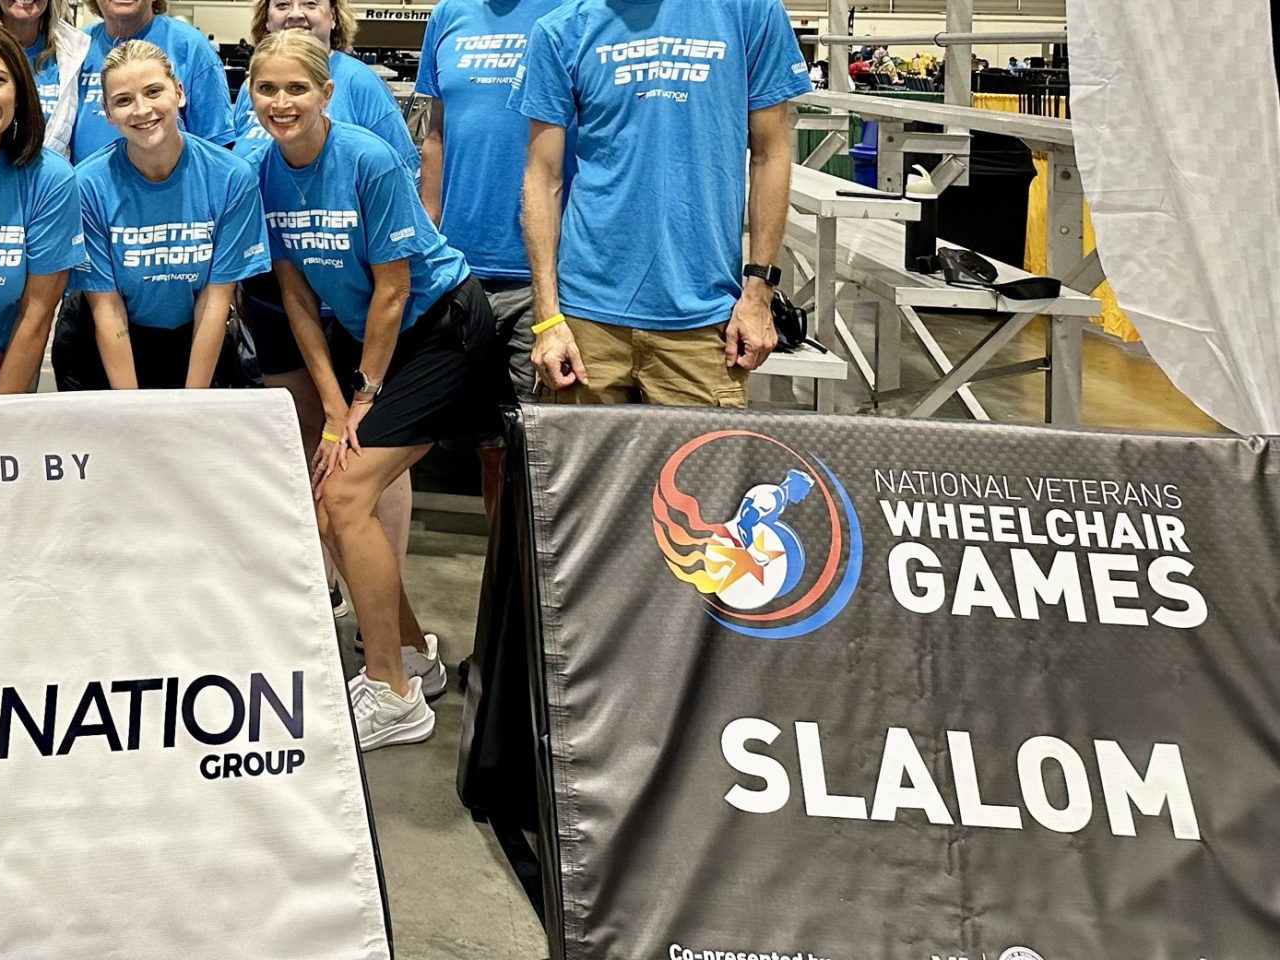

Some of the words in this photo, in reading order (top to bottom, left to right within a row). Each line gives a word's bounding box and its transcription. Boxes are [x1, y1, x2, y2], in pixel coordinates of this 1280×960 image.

[366, 9, 431, 20] Refreshm
[454, 34, 528, 52] TOGETH
[596, 36, 727, 64] TOGETHER
[456, 53, 524, 68] STRO
[614, 60, 710, 85] STRONG
[265, 209, 358, 228] TOGETHER
[282, 232, 351, 250] STRONG
[123, 243, 214, 268] STRONG
[44, 454, 90, 481] BY
[874, 468, 1022, 501] NATIONAL
[1026, 476, 1183, 510] VETERANS
[879, 500, 1191, 553] WHEELCHAIR
[887, 541, 1209, 629] GAMES
[199, 748, 306, 781] GROUP
[720, 716, 1202, 841] SLALOM
